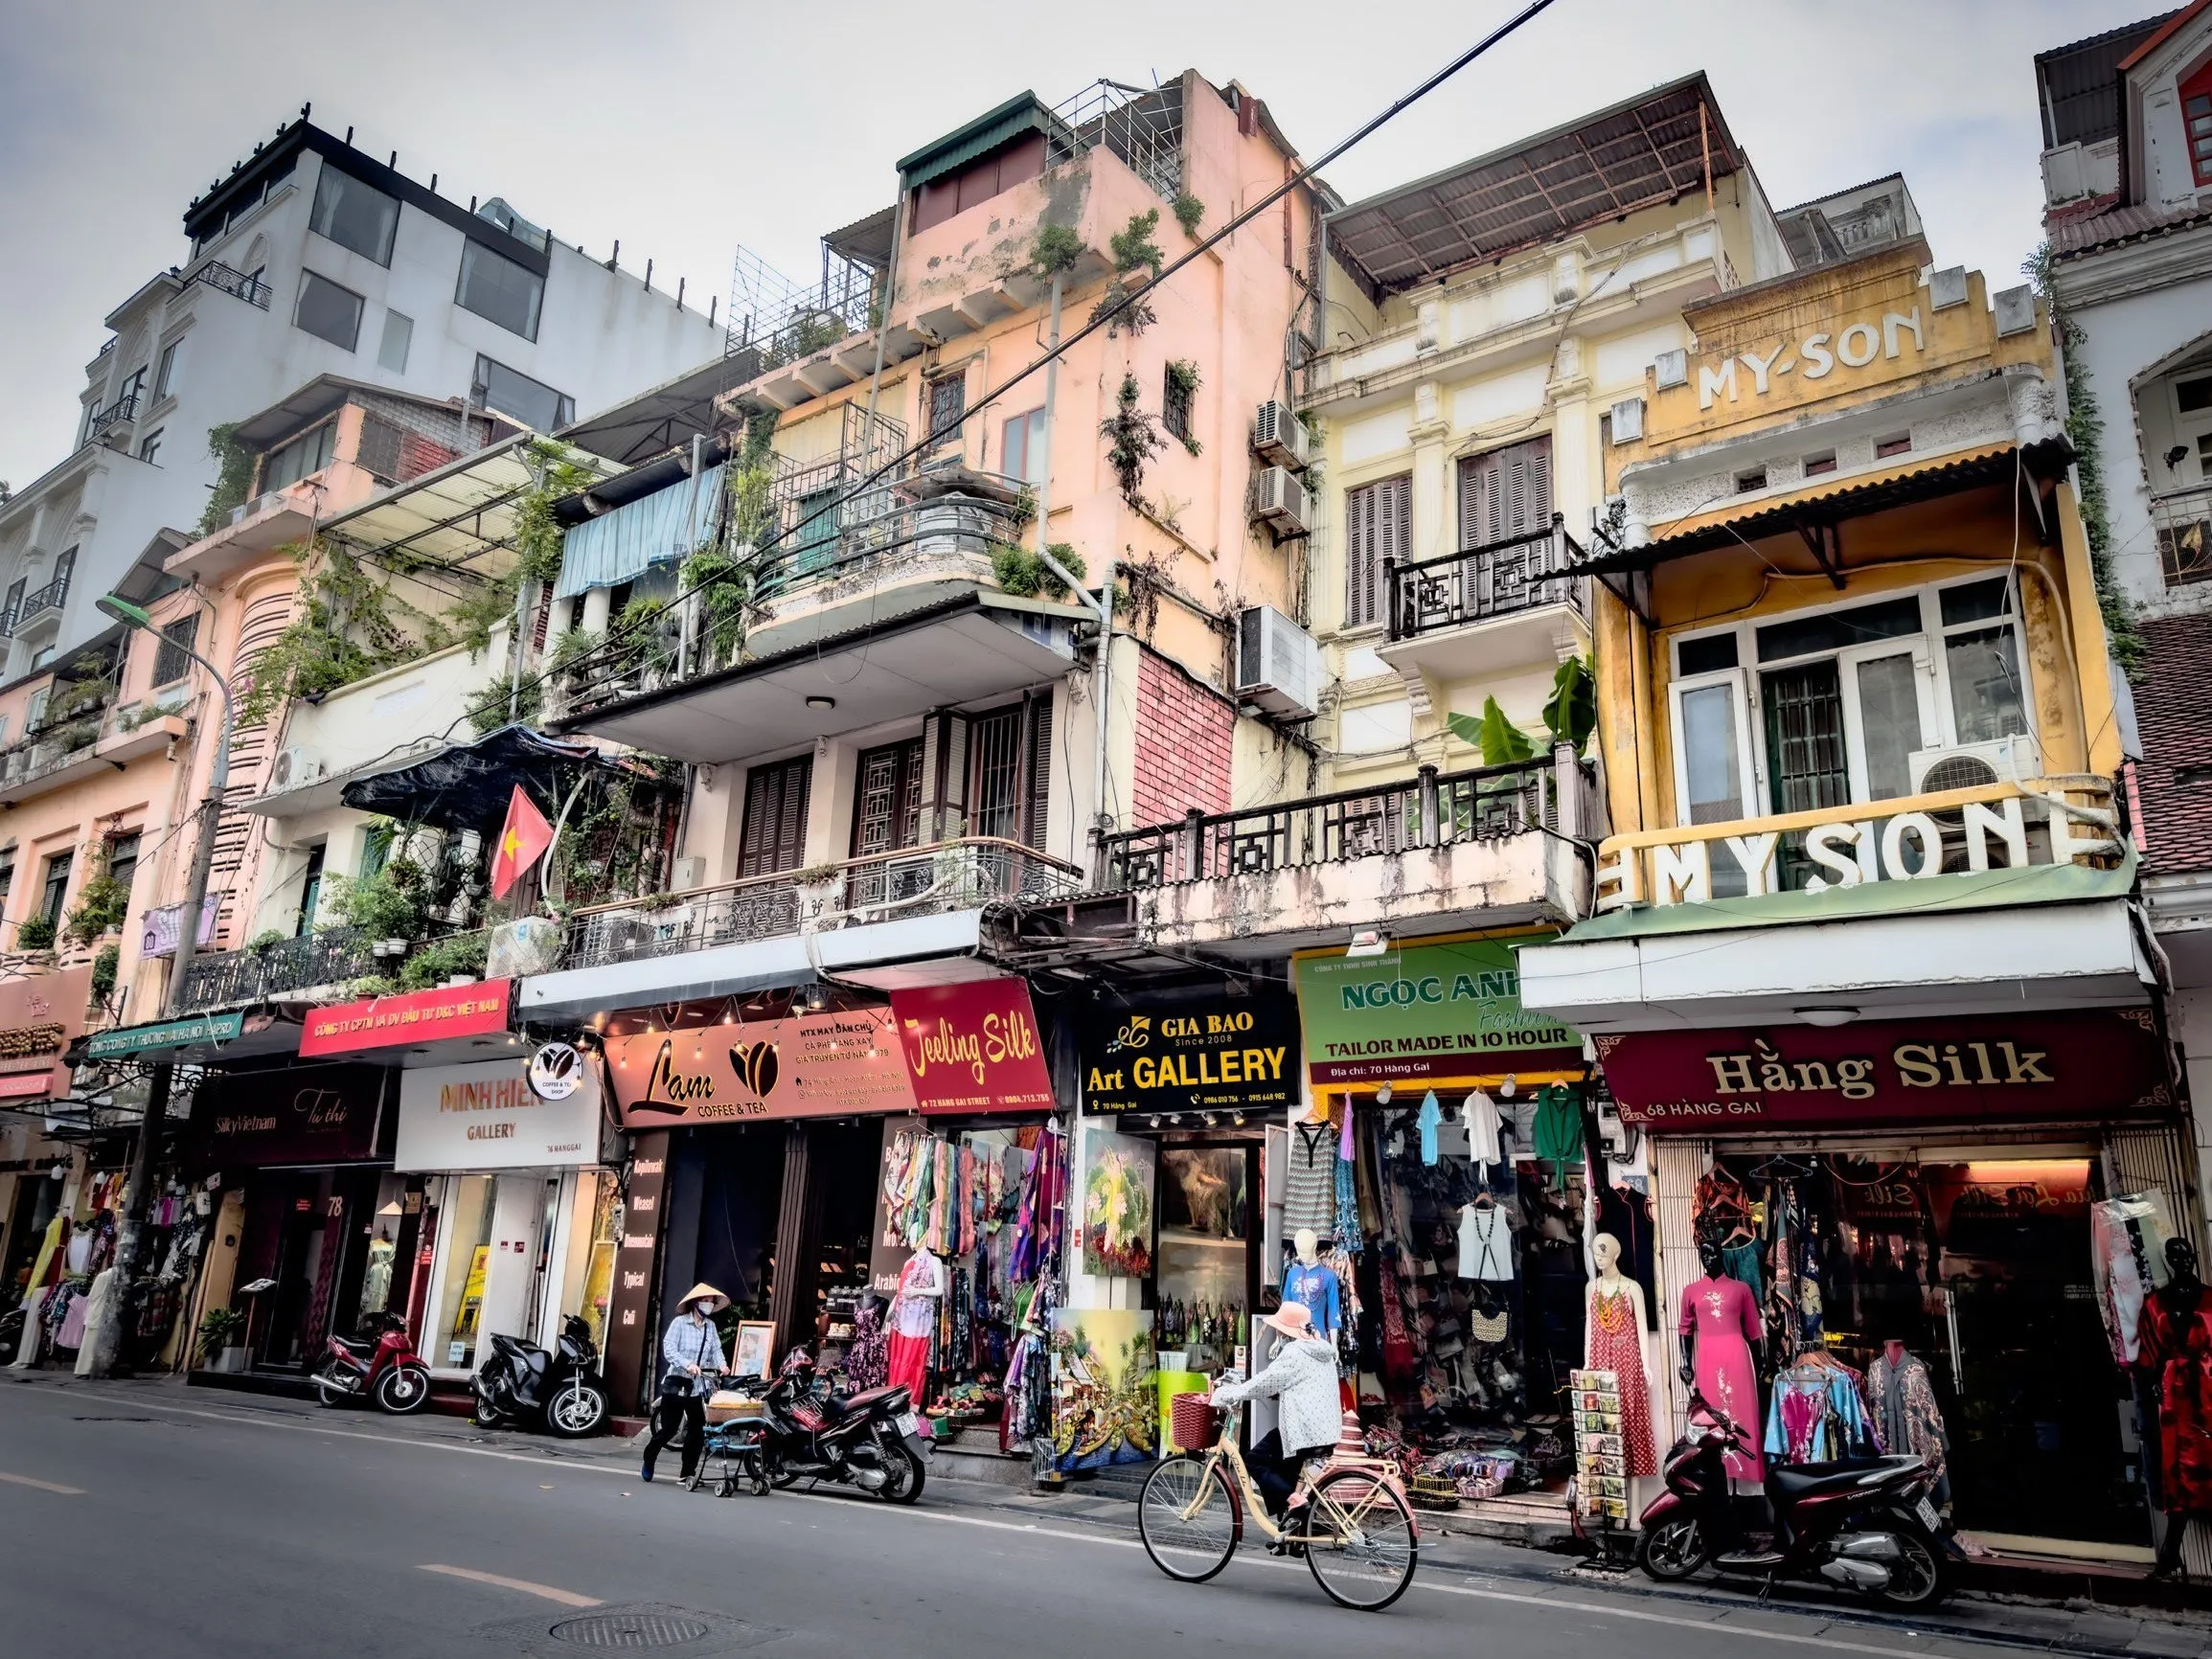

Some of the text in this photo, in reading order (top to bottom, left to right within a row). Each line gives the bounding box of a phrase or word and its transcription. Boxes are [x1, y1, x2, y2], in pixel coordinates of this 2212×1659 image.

[1699, 306, 1924, 410] MY-SON
[1653, 798, 2029, 906] MY SON
[1341, 976, 1443, 1011] NGỌC
[817, 1026, 833, 1036] MAY
[1161, 1011, 1254, 1038] GIA BAO
[835, 1038, 855, 1049] ANG
[983, 1010, 1036, 1063] Silk
[1174, 1034, 1232, 1047] Since 2008
[1325, 1028, 1568, 1057] TAILOR MADE IN 10 HOUR
[1086, 1046, 1287, 1092] Art GALLERY
[1893, 1041, 2055, 1088] Silk
[439, 1080, 491, 1112] MINH
[968, 1097, 991, 1106] STREET
[1647, 1099, 1762, 1116] 68 HÀNG GAI
[697, 1102, 768, 1118] COFFEE & TEA
[467, 1122, 516, 1141] GALLERY
[328, 1196, 343, 1216] 78
[624, 1271, 645, 1289] Typical
